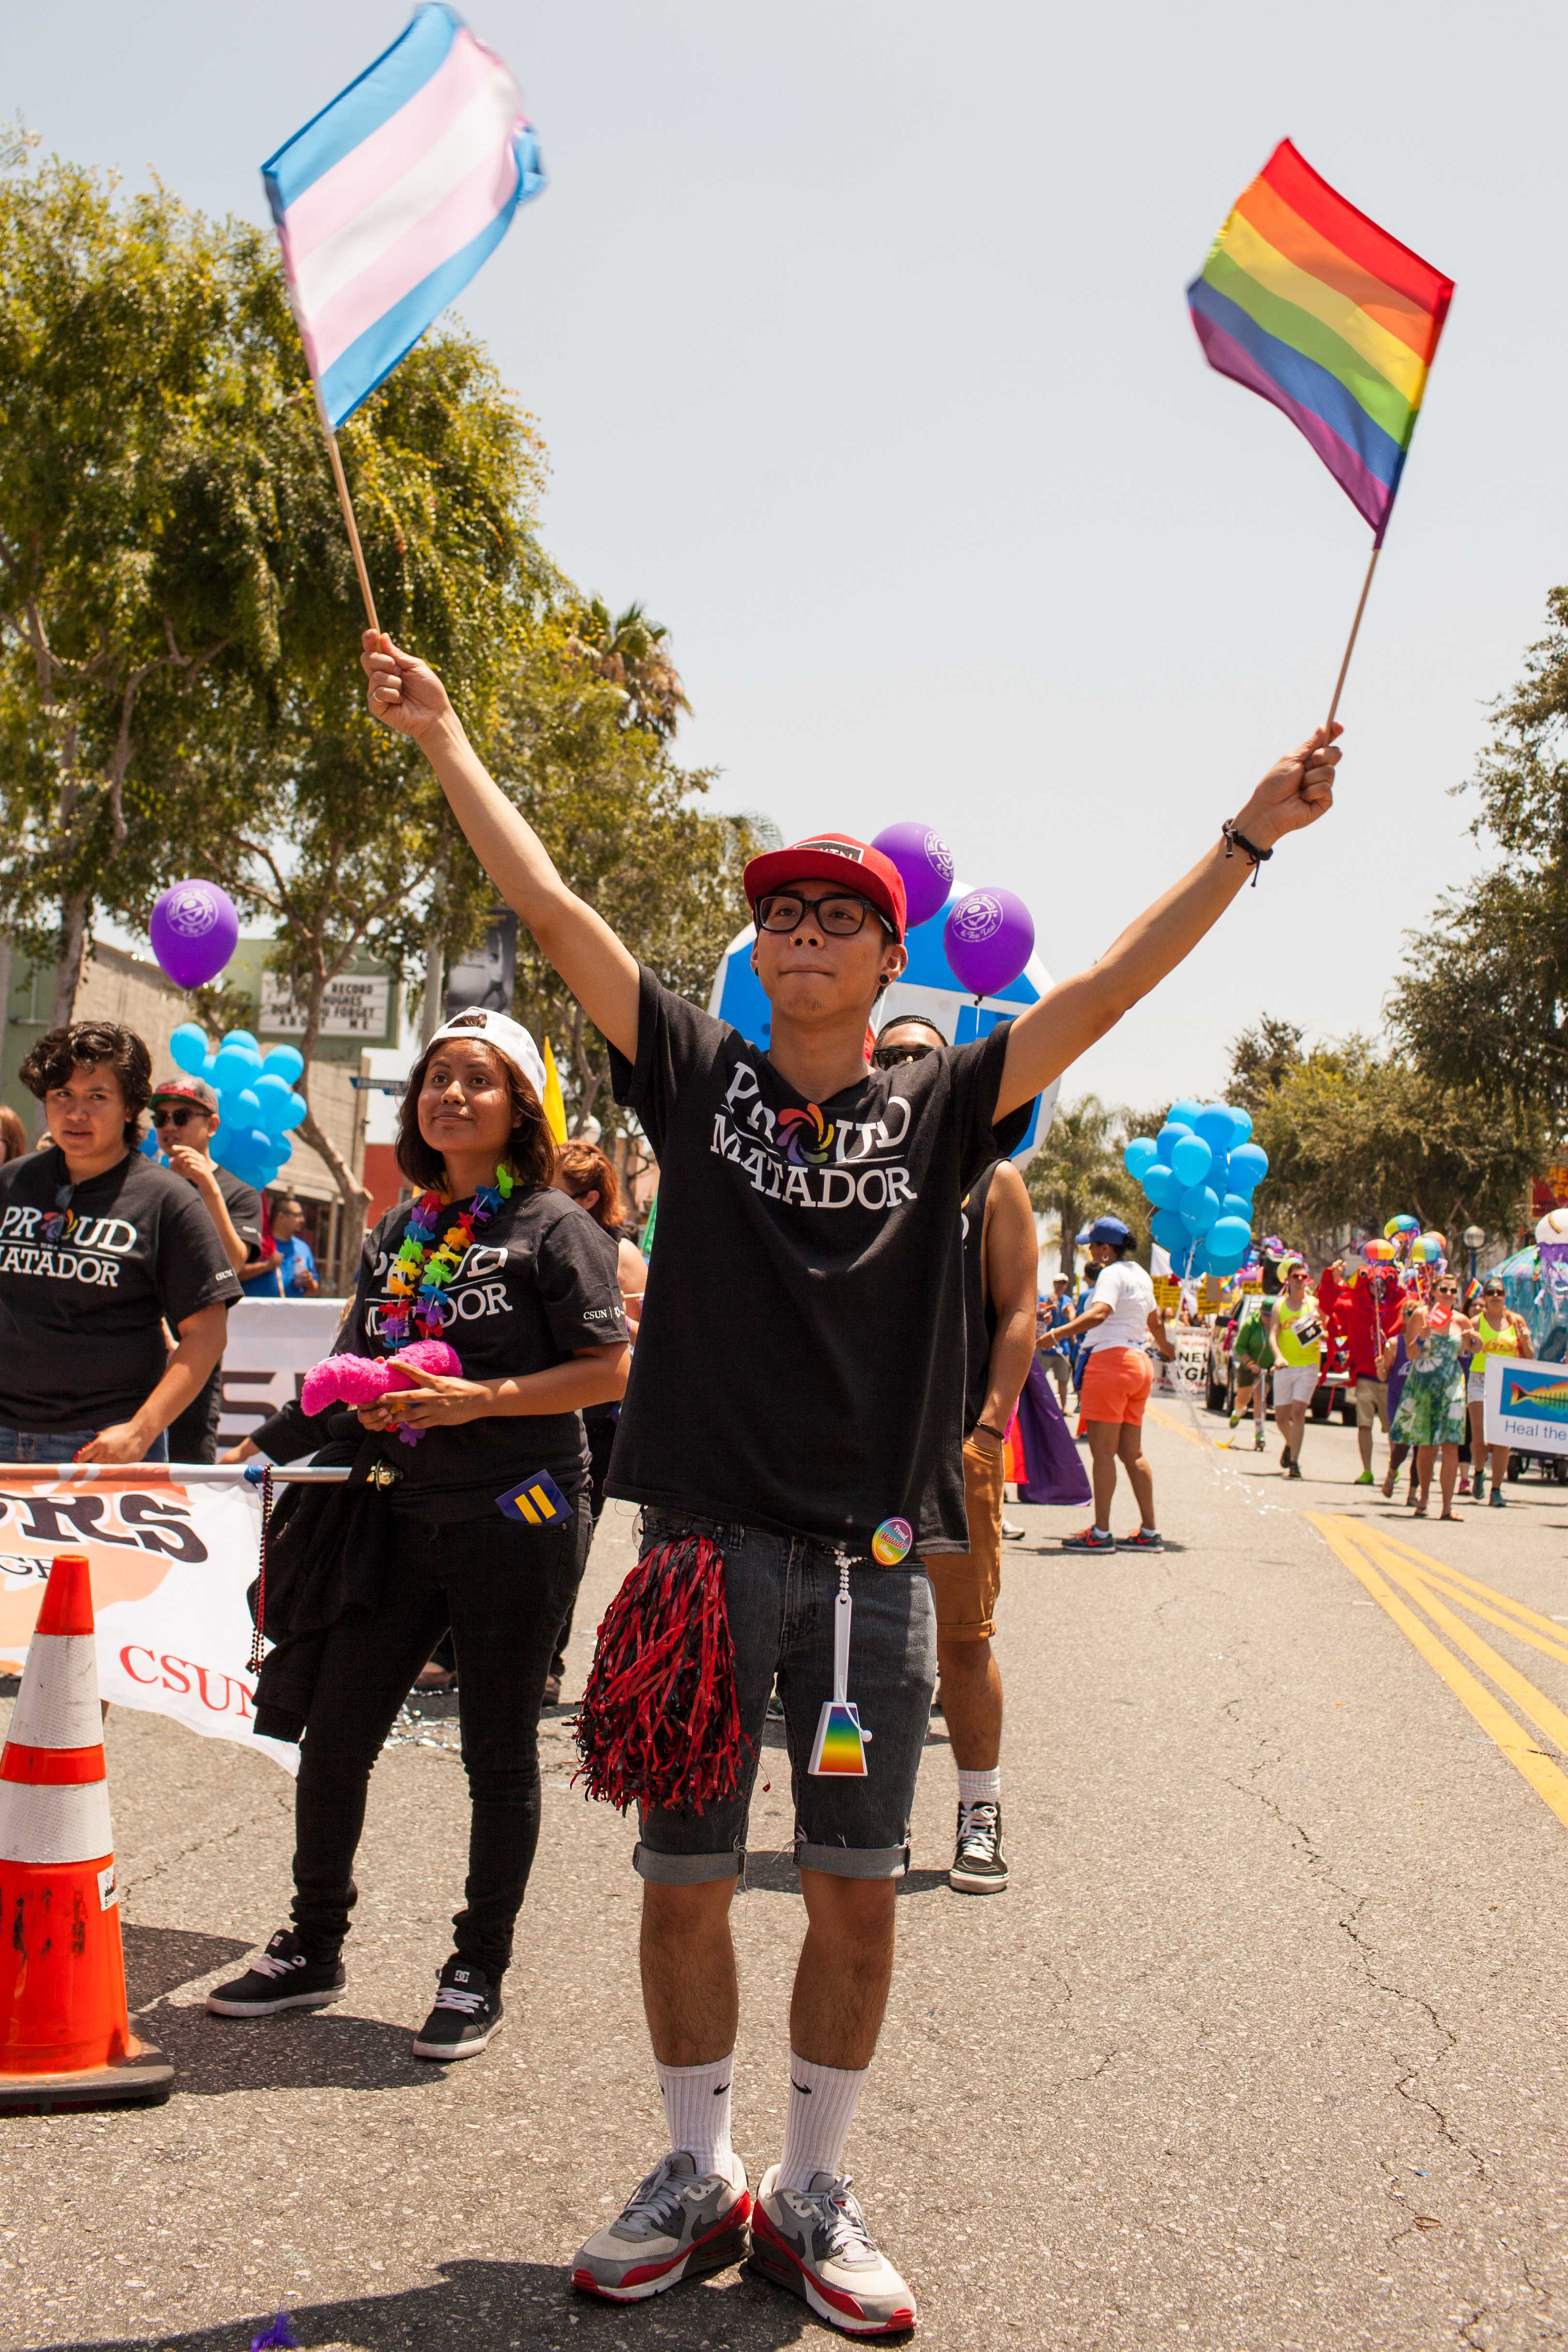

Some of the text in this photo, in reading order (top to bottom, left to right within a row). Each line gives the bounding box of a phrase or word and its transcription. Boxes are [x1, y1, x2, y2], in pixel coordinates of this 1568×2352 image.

[332, 983, 374, 995] RECORD
[279, 1015, 326, 1028] ABOT
[334, 1006, 375, 1018] FORGET
[725, 1061, 911, 1163] PROUD
[710, 1113, 917, 1210] MATADOR
[0, 1206, 137, 1252] PROUD
[583, 1309, 607, 1320] CSUN
[1505, 1419, 1567, 1441] Heal the
[0, 1492, 209, 1563] RS
[893, 1524, 909, 1540] Proud
[878, 1532, 909, 1551] Matador
[120, 1645, 255, 1719] CSUN
